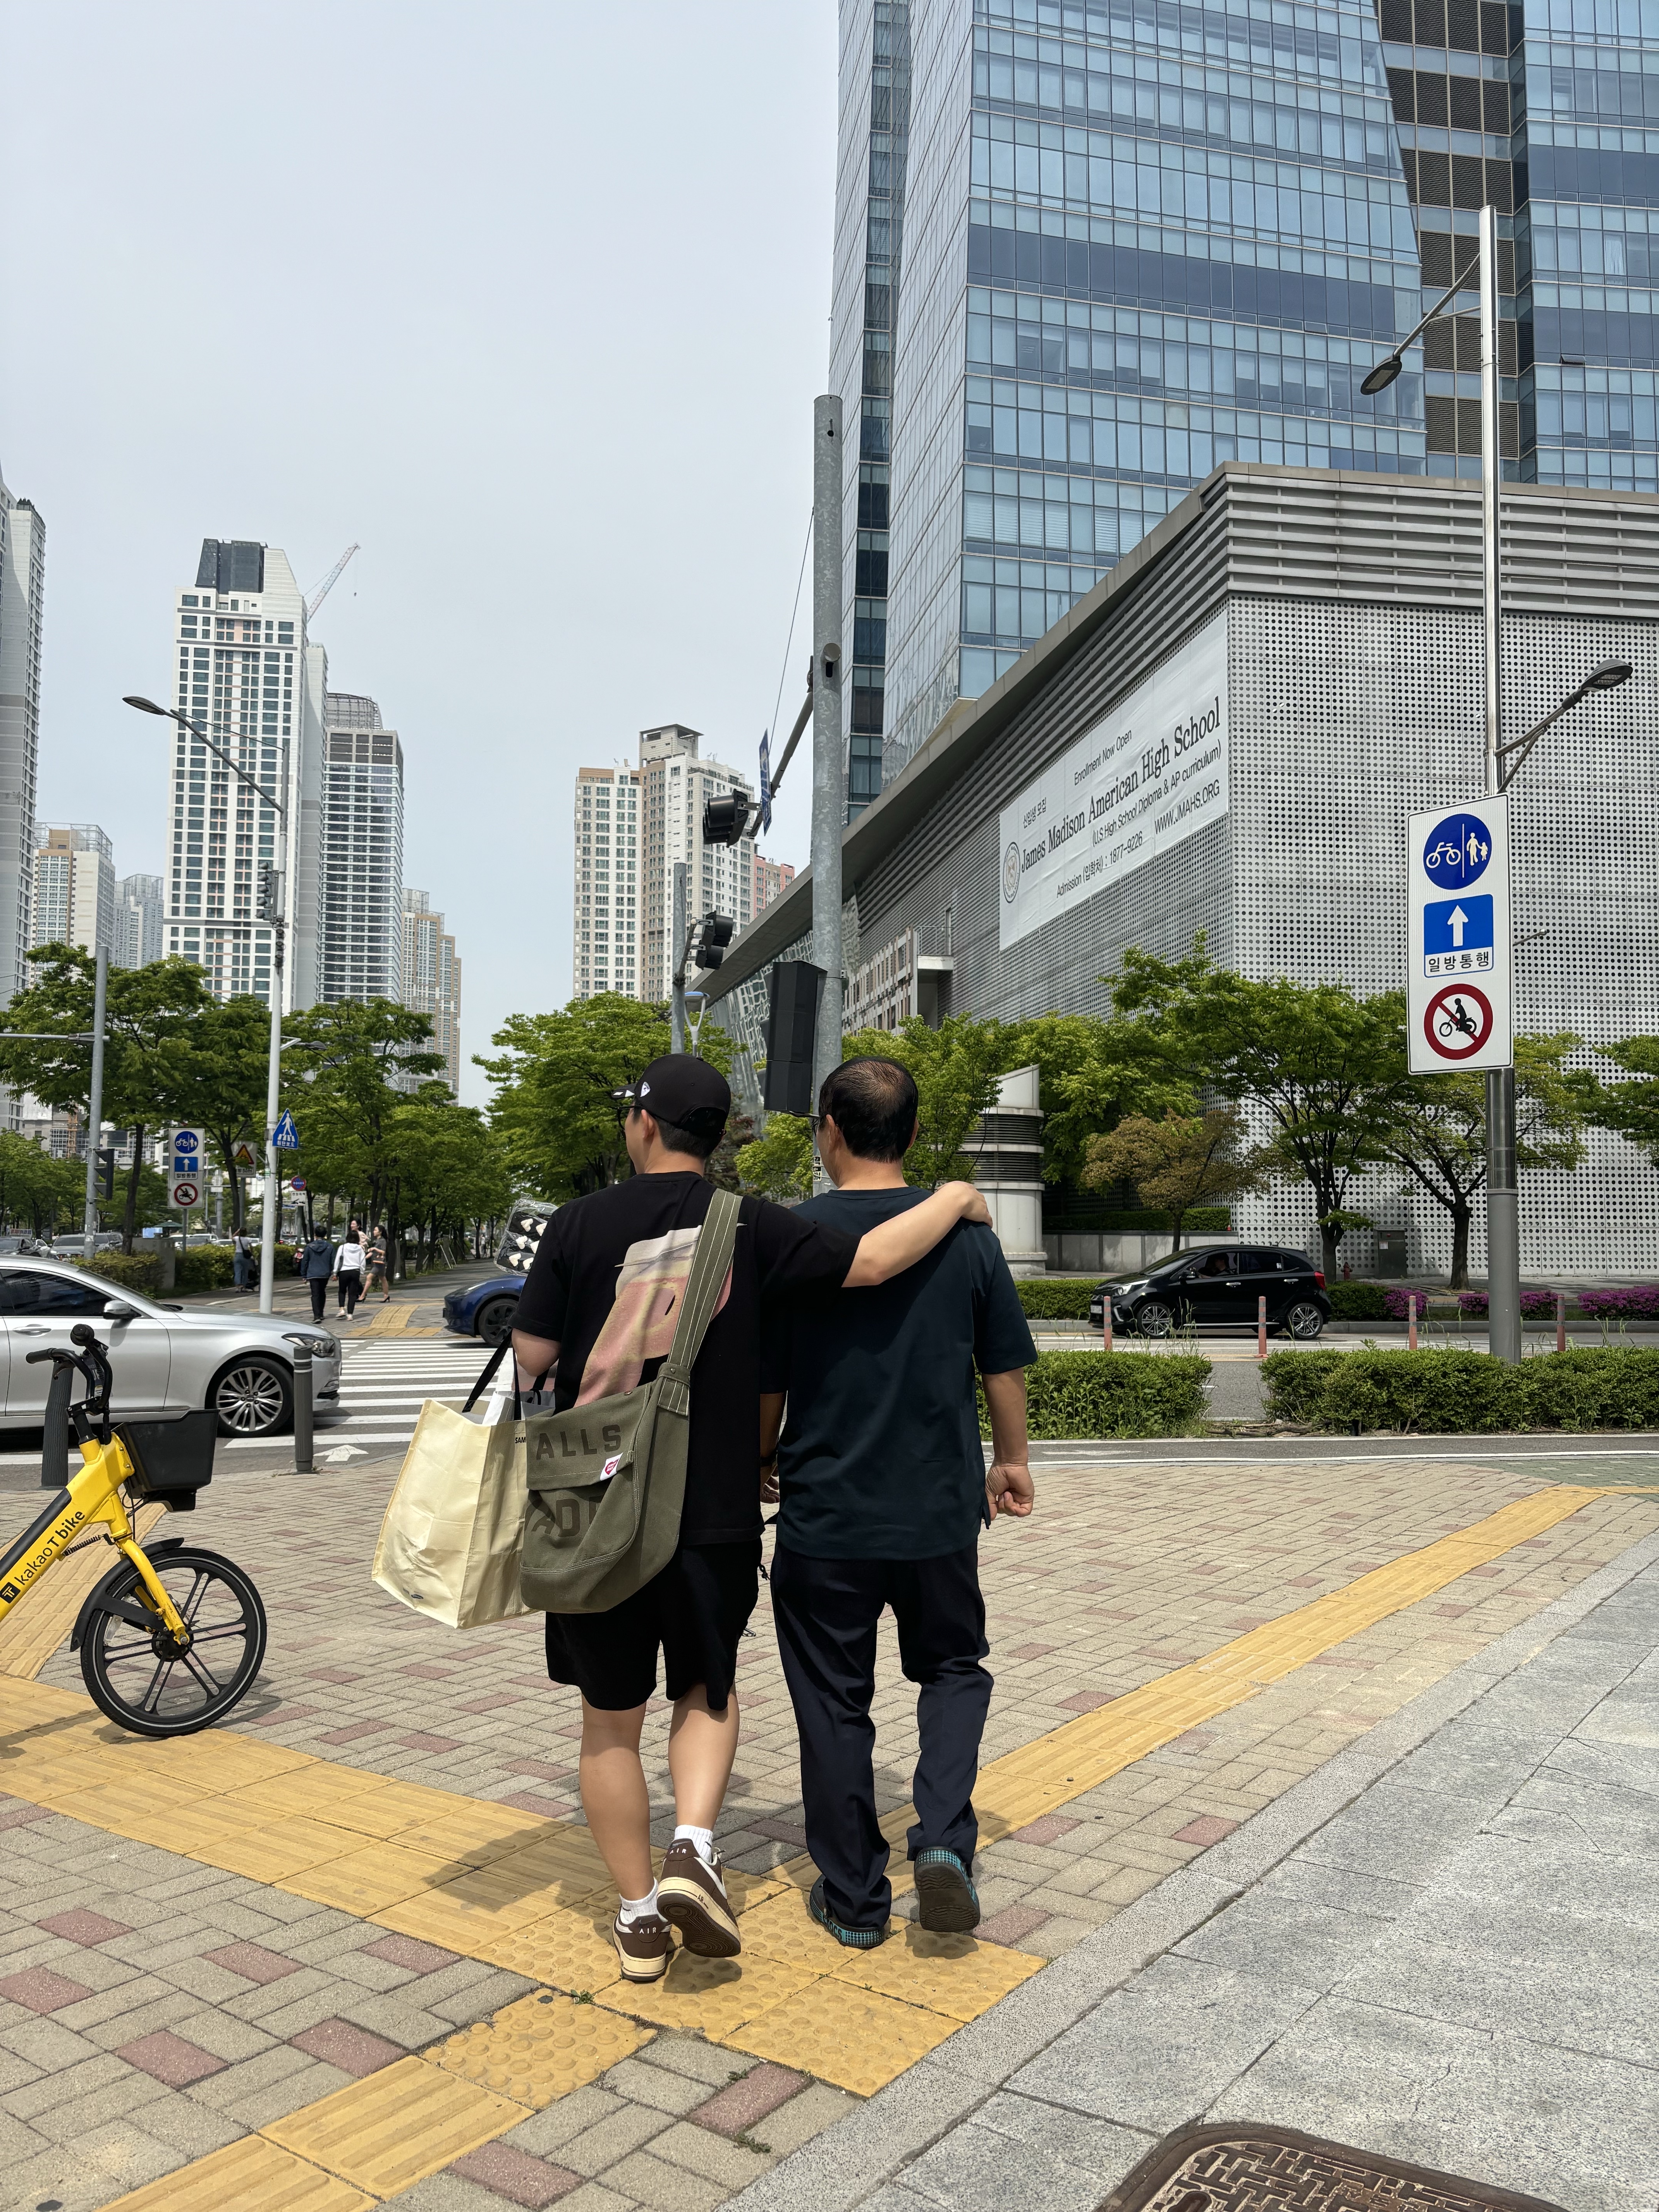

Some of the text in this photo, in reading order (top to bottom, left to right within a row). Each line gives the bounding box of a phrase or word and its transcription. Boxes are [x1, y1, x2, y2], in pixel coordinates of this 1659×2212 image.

[1074, 730, 1132, 786] Enrollment Now Open
[1022, 840, 1046, 873] James
[1048, 812, 1085, 854] Madison
[1088, 771, 1139, 824] American
[1142, 738, 1170, 784] High
[1175, 696, 1220, 759] School
[1092, 738, 1221, 848] (U.S High School Diploma & AP curriculum)
[1023, 797, 1046, 829] 신입생 모집
[1056, 874, 1082, 898] Admission
[1083, 855, 1103, 883] (입학처)
[1110, 831, 1142, 865] 1877-9226
[1154, 779, 1220, 835] WWW.JMAHS.ORG
[1429, 951, 1489, 972] 일방통행
[536, 1425, 621, 1460] ALLS
[55, 1511, 85, 1539] bike
